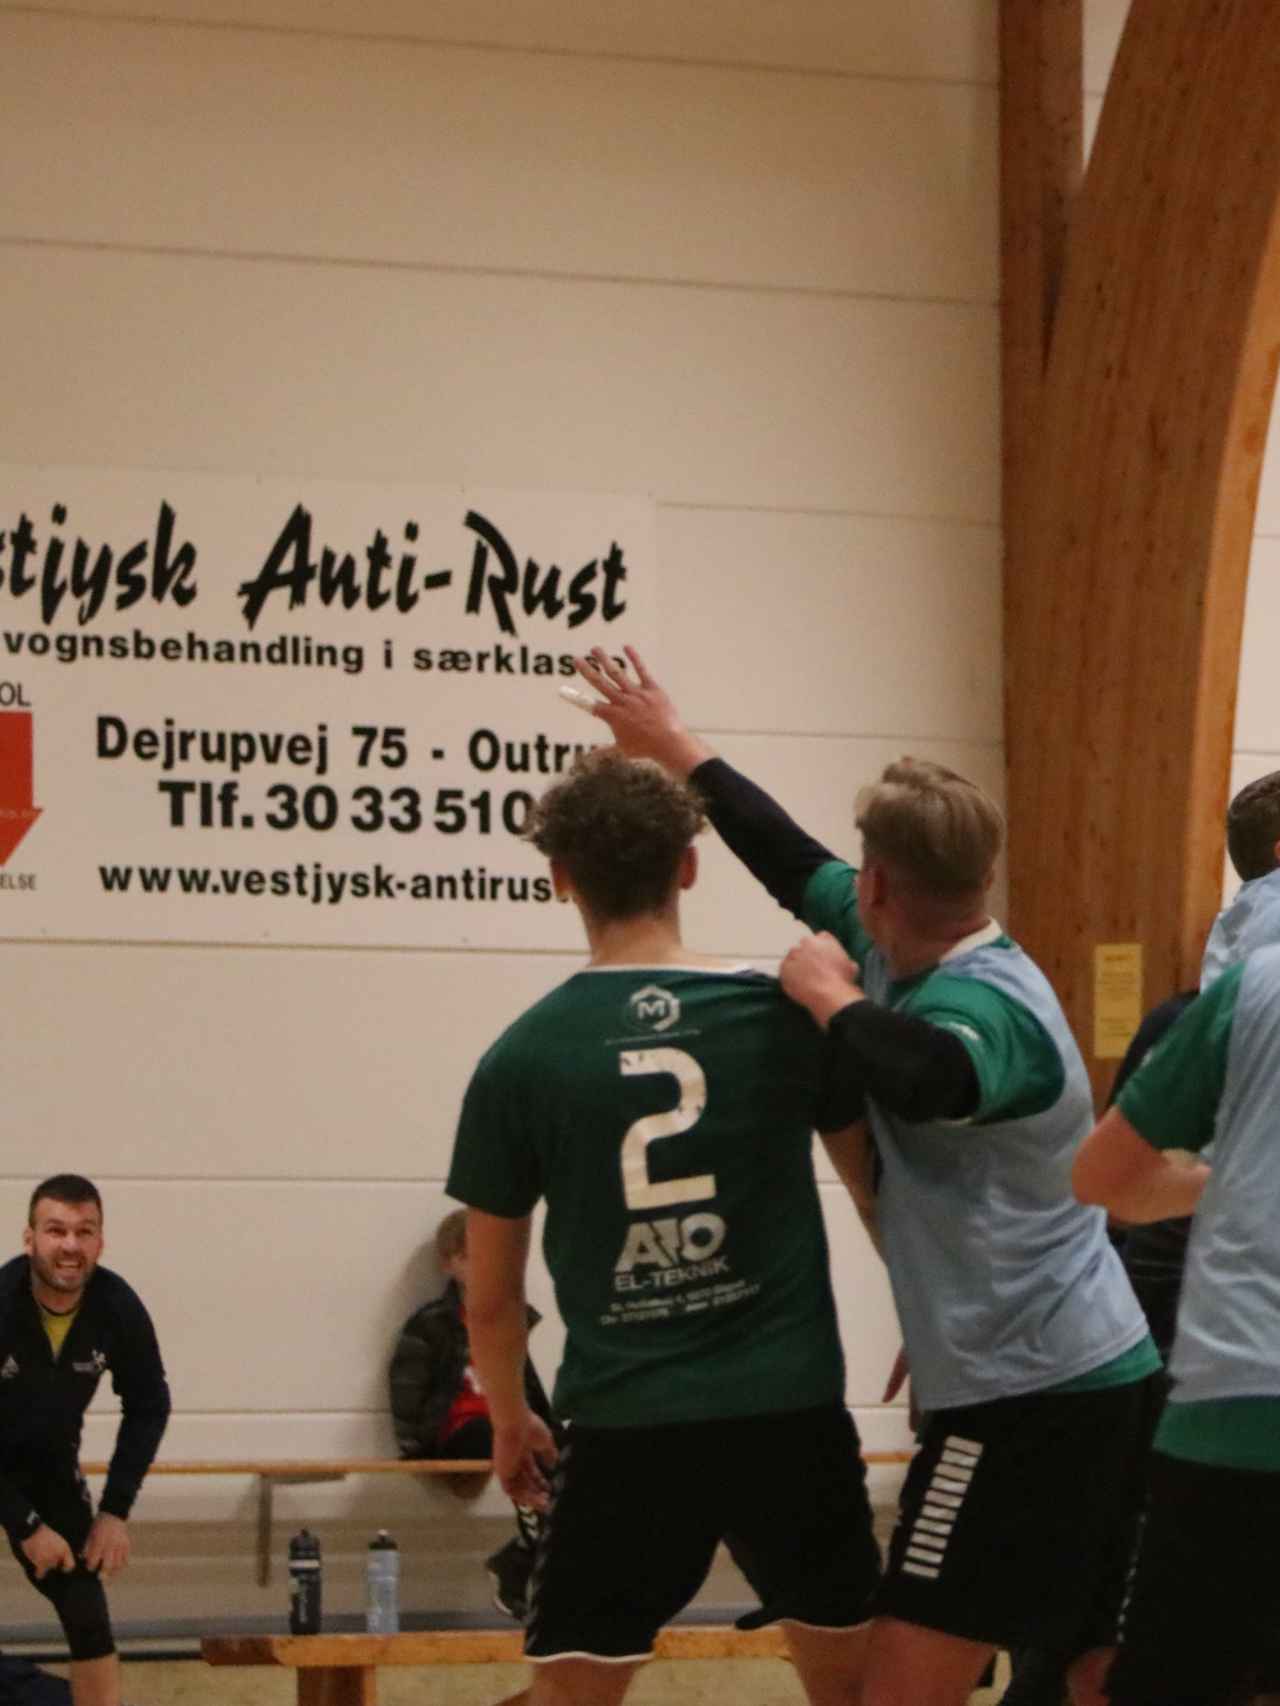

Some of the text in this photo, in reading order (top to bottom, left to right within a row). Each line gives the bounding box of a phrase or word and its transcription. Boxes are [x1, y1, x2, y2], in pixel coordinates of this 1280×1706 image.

[0, 500, 627, 638] tjysk Anti-Rust
[3, 629, 364, 674] vognsbehandling
[384, 639, 393, 670] i
[0, 681, 31, 707] OL
[96, 715, 328, 775] Dejrupvej
[351, 726, 408, 767] 75
[468, 729, 592, 773] Outr
[158, 780, 538, 836] Tlf. 30 33 510
[0, 872, 37, 891] ELSE
[99, 862, 571, 906] www.vestjysk-antirus
[619, 1046, 717, 1211] 2
[614, 1254, 731, 1292] EL-TEKNIK
